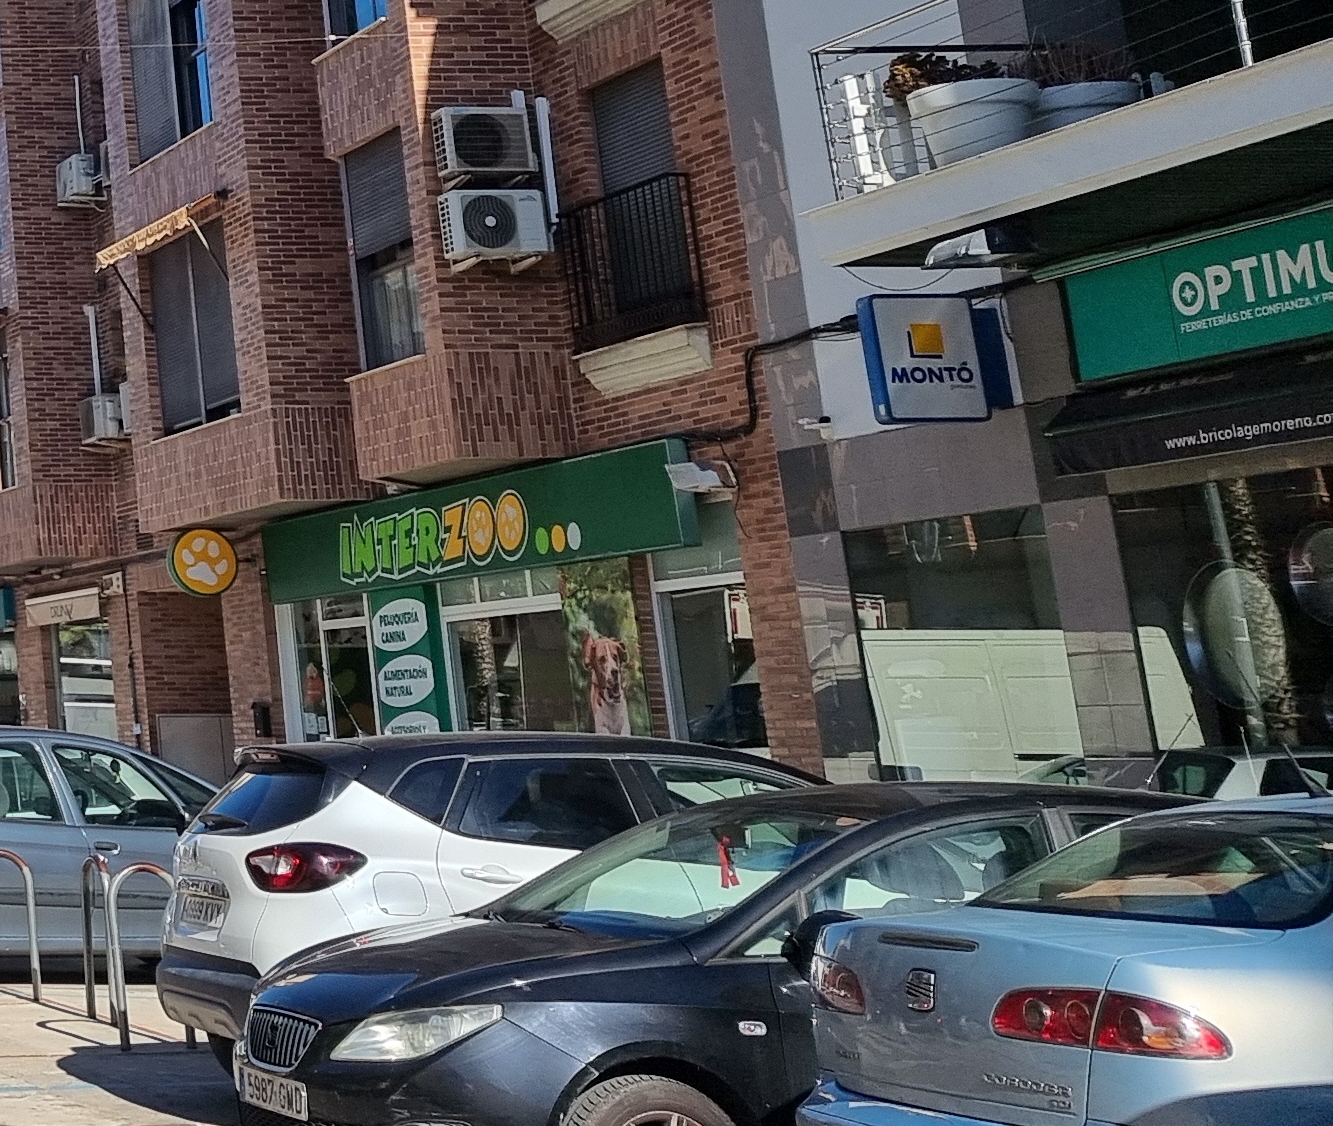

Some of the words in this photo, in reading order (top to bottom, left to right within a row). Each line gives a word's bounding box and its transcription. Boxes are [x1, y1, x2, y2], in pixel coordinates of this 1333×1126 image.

[1180, 312, 1240, 334] FERRETERÍAS
[1240, 308, 1254, 321] DE
[1254, 296, 1313, 318] CONFIANZA
[1312, 295, 1322, 307] Y
[891, 361, 974, 384] MONTÓ
[1164, 413, 1333, 450] www.bricolagemoreno.co
[247, 1072, 275, 1106] 5987
